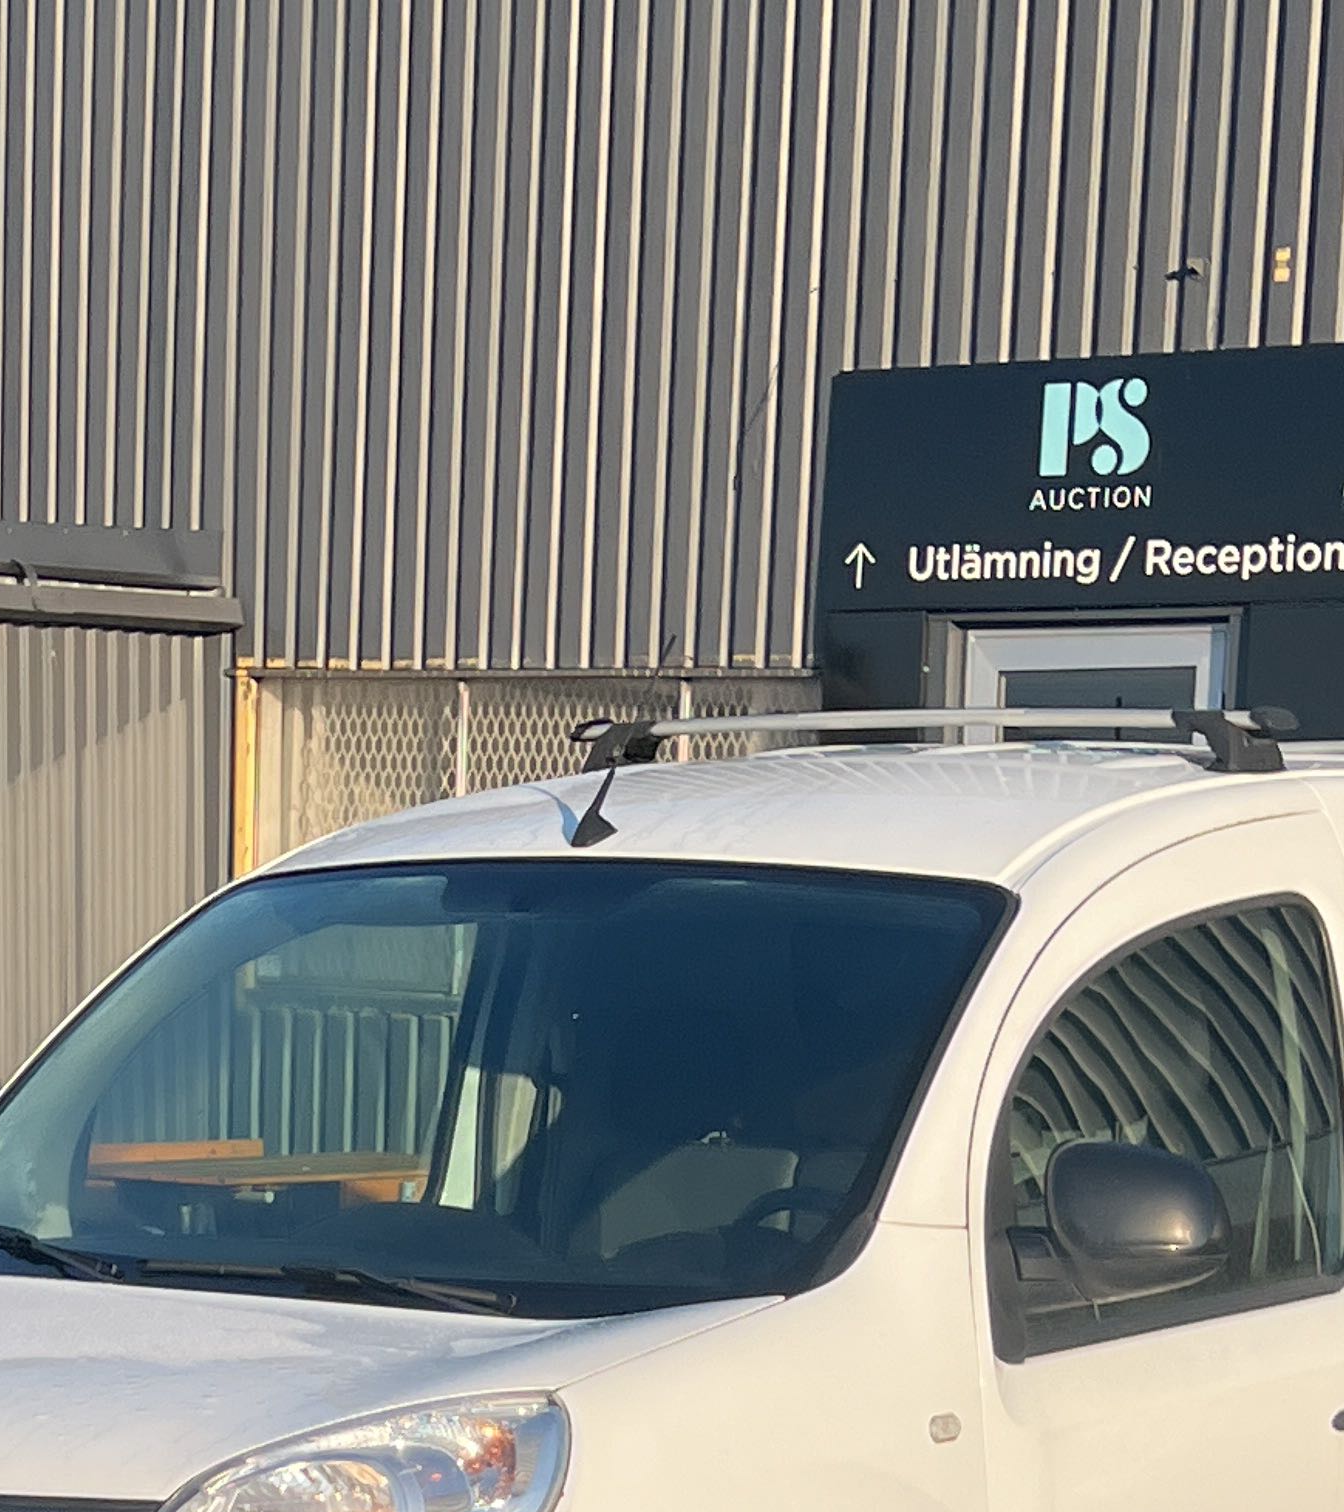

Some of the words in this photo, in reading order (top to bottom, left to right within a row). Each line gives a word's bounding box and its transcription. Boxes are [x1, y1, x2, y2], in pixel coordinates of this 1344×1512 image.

[1039, 377, 1151, 476] PS
[1028, 485, 1152, 511] AUCTION
[908, 541, 1101, 584] Utlämning
[1109, 535, 1137, 583] /
